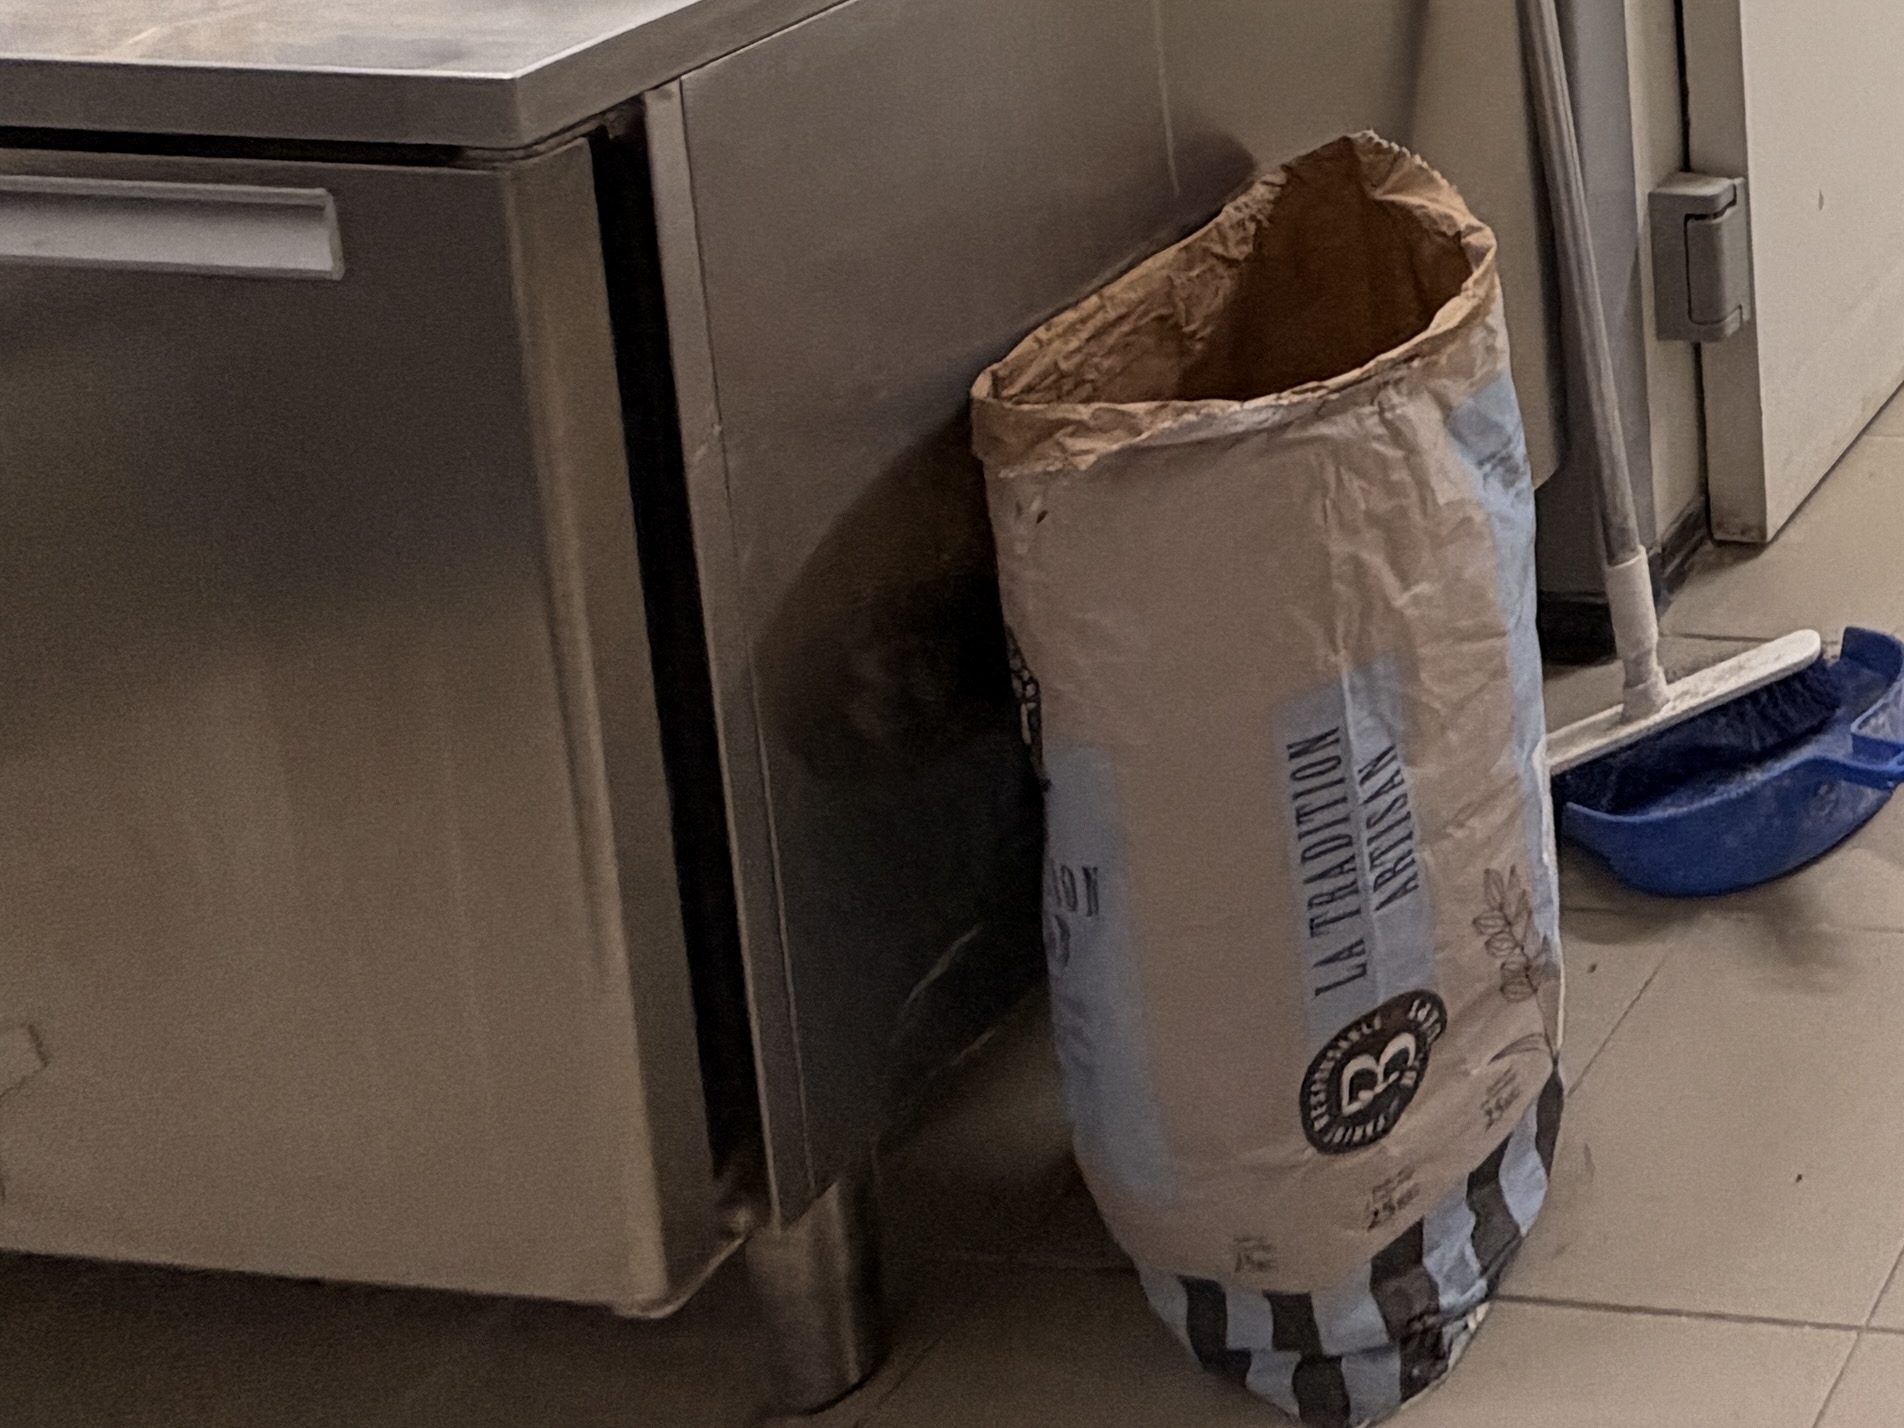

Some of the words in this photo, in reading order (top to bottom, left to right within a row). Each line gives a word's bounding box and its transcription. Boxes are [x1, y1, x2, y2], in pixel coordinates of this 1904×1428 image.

[1286, 726, 1362, 939] TRADITION
[1357, 744, 1420, 913] ARTISAN
[1312, 937, 1368, 997] LA
